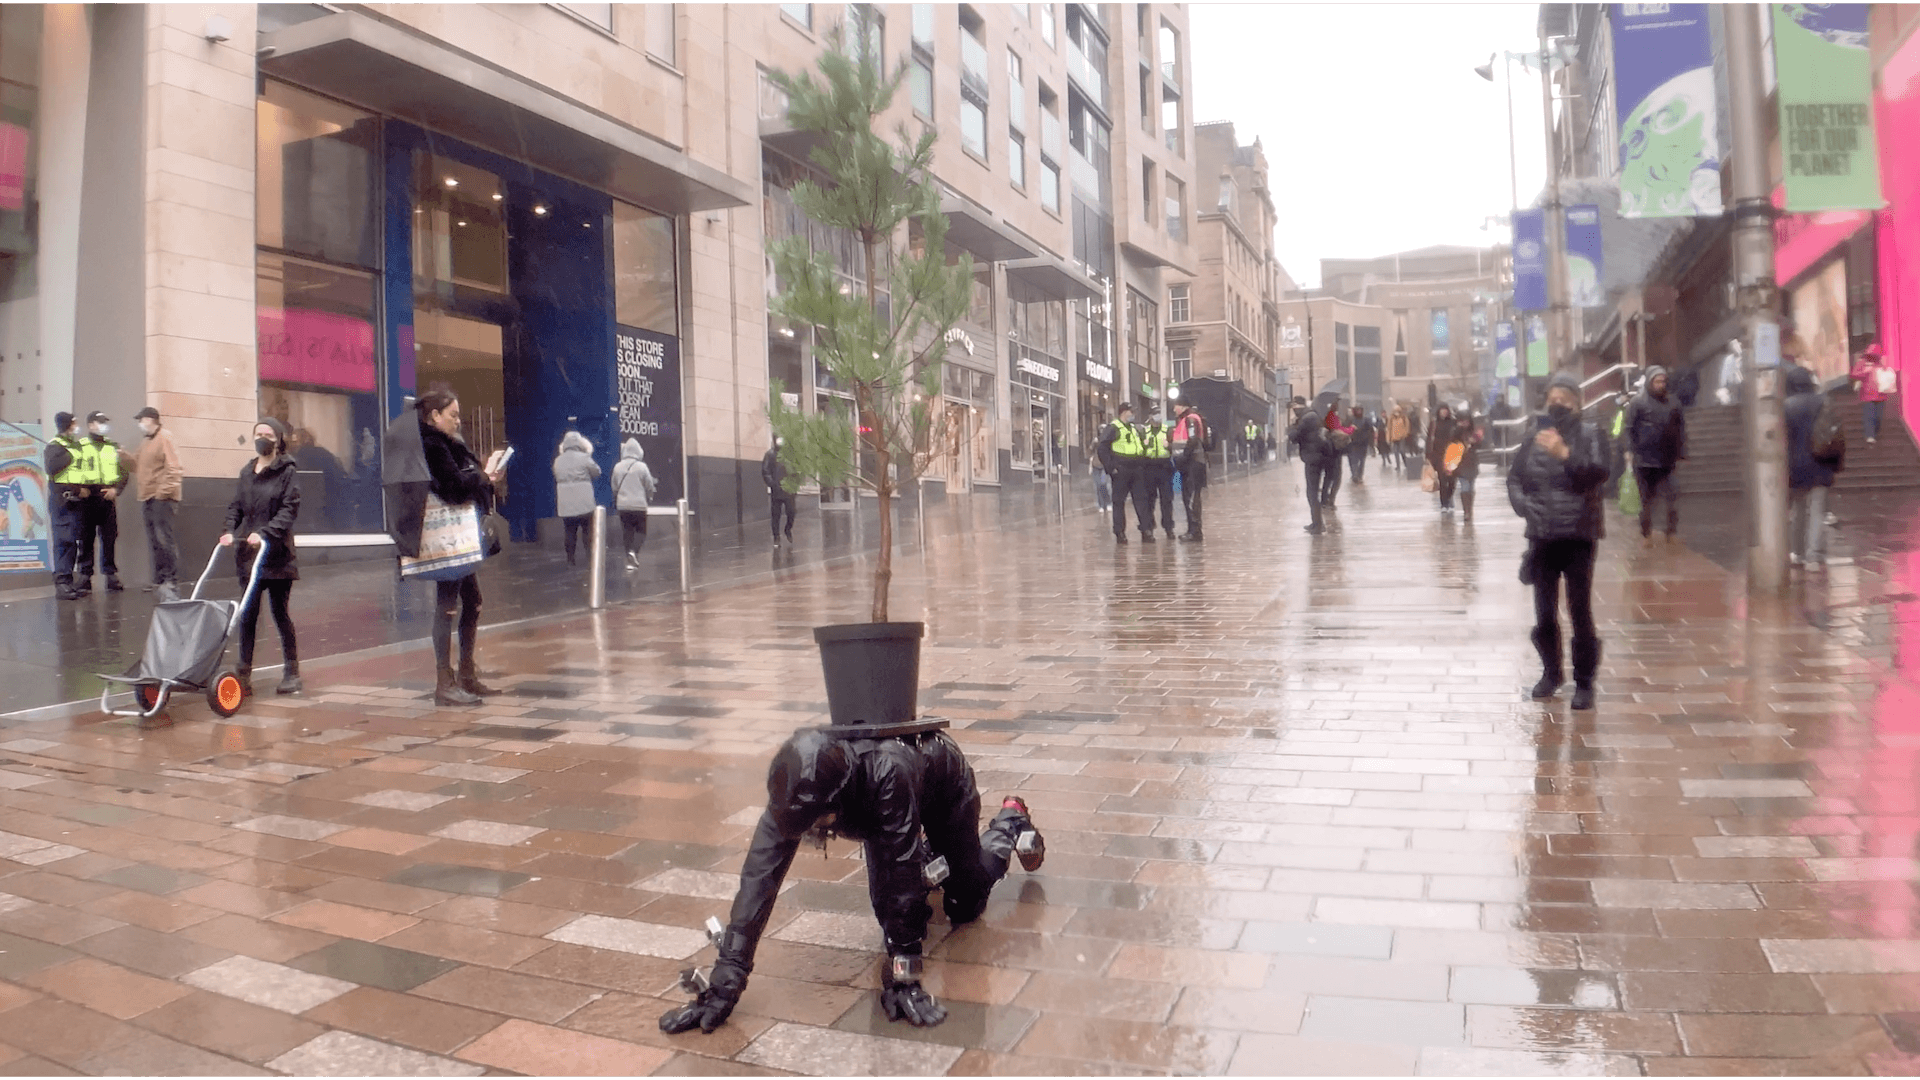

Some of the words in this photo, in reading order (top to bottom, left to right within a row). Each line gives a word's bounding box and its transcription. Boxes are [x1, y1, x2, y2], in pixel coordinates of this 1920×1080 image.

[1784, 104, 1868, 126] TOGETHER
[1789, 130, 1820, 151] FOR
[1824, 128, 1858, 151] OUR
[1790, 153, 1851, 176] PLANET
[616, 334, 634, 350] THIS
[635, 338, 664, 357] STORE
[616, 349, 623, 362] S
[625, 350, 663, 369] CLOSING
[633, 379, 654, 394] THAT
